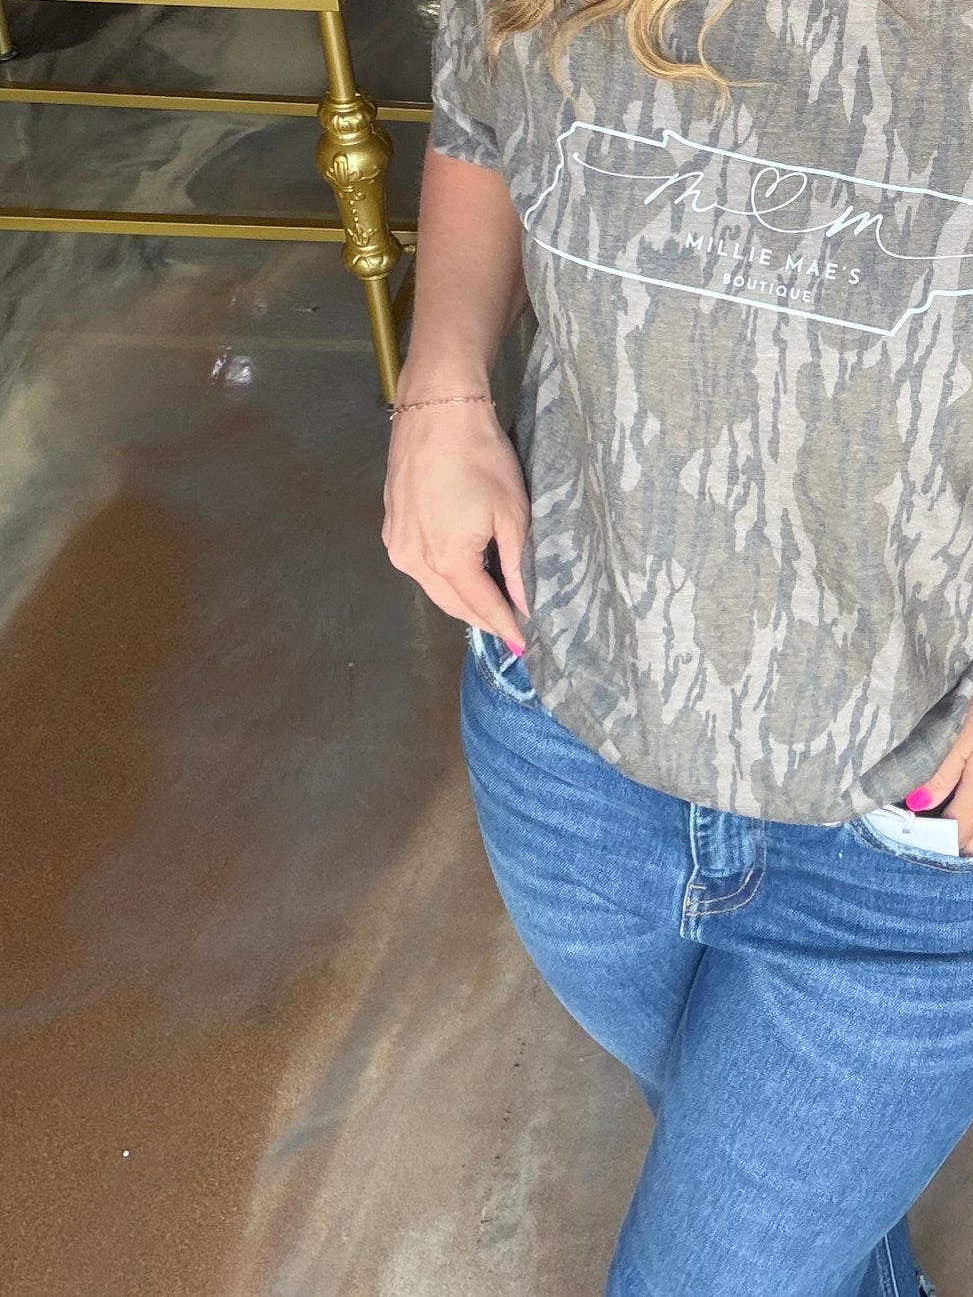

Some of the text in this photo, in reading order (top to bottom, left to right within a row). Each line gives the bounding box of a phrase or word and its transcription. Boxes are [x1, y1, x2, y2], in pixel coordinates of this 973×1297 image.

[685, 233, 861, 285] MILLIE MAE'S
[723, 273, 812, 303] BOUTIQUE
